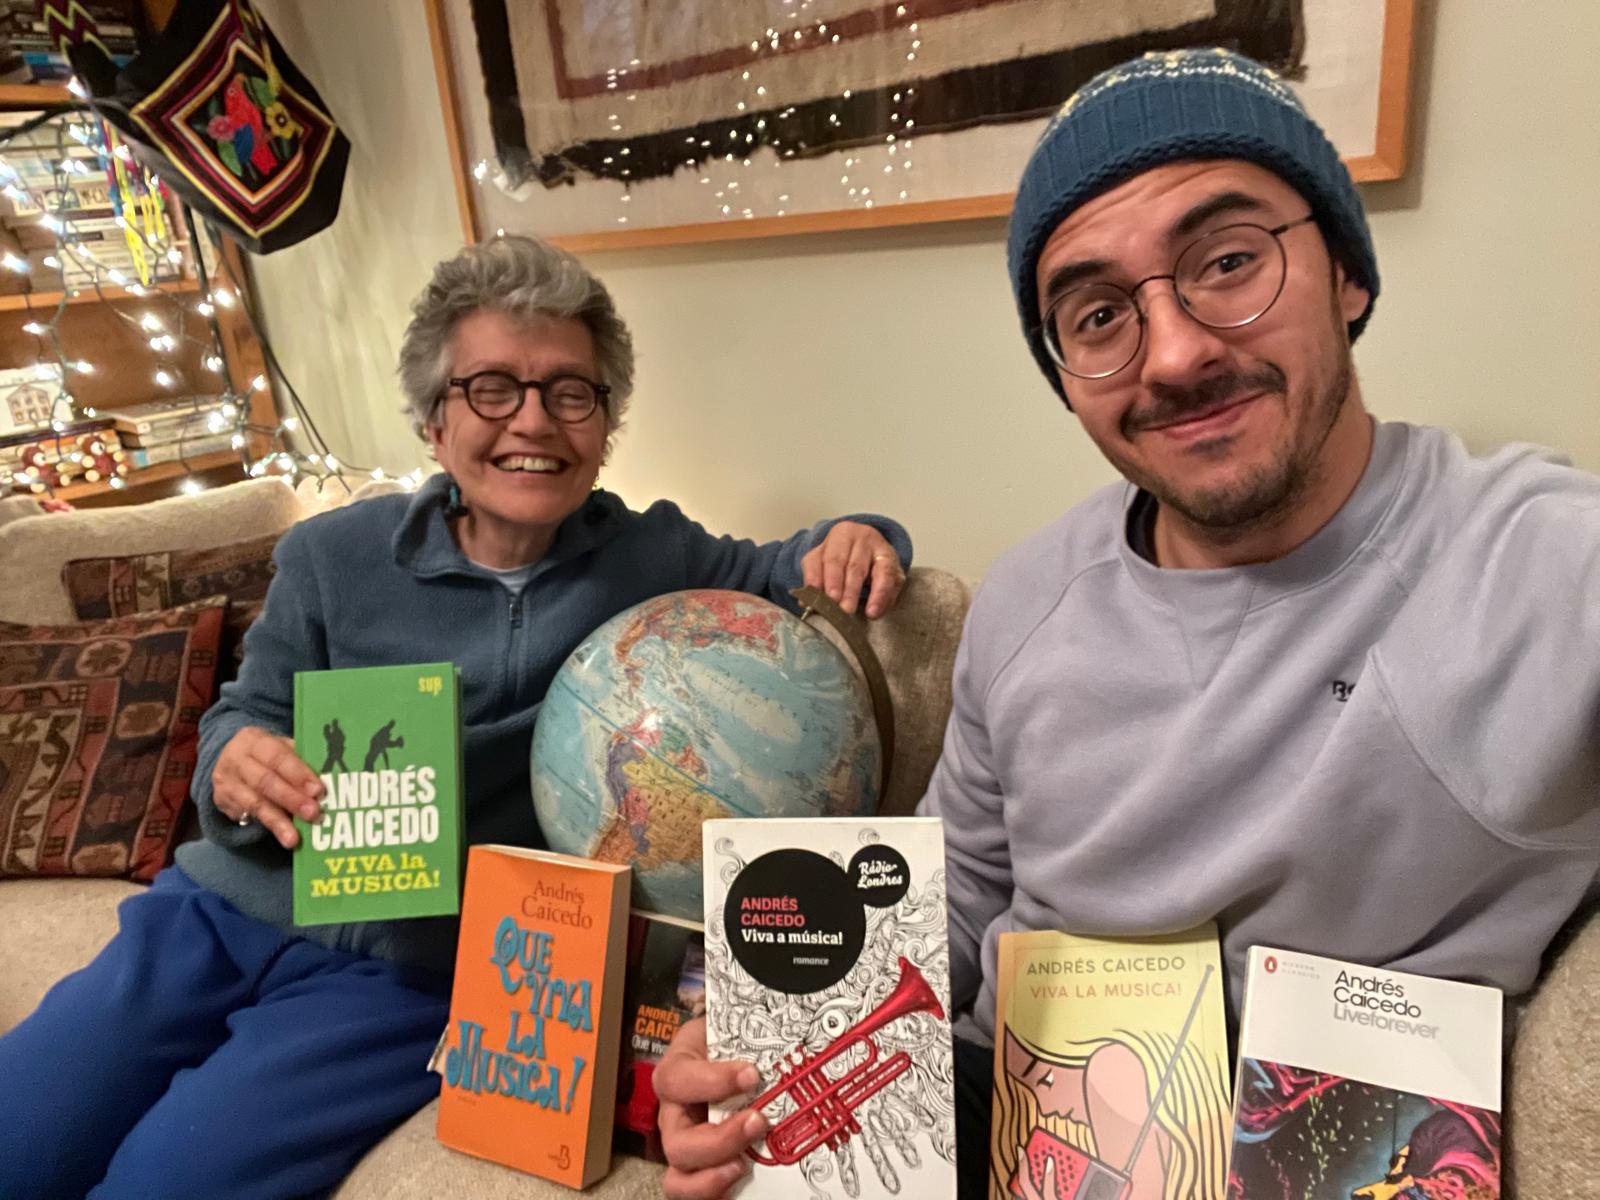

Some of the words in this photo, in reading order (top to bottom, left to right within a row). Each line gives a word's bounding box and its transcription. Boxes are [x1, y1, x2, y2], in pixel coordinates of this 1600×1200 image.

[320, 764, 436, 811] ANDRÉS
[312, 805, 439, 851] CAICEDO
[324, 854, 397, 875] VIVA
[400, 852, 426, 870] la
[858, 860, 897, 875] Rádio
[534, 879, 585, 905] Andrés
[857, 873, 903, 889] Londres
[521, 895, 593, 930] Caicedo
[741, 895, 798, 911] ANDRÉS
[741, 913, 805, 927] CAICEDO
[741, 929, 774, 943] Viva
[777, 933, 786, 943] a
[788, 929, 844, 945] música!
[490, 915, 554, 994] QUE
[793, 957, 829, 966] romance
[1027, 957, 1095, 976] ANDRÉS
[1102, 956, 1185, 973] CAICEDO
[1031, 986, 1068, 999] VIVA
[1076, 985, 1097, 998] LA
[1104, 983, 1182, 997] MUSICA!
[1334, 970, 1404, 998] Andrés
[522, 971, 593, 1031] VIVA
[1333, 986, 1421, 1019] Caicedo
[1334, 1002, 1440, 1039] Liveforever
[506, 1010, 546, 1059] LA
[445, 1020, 586, 1113] MUSICA!
